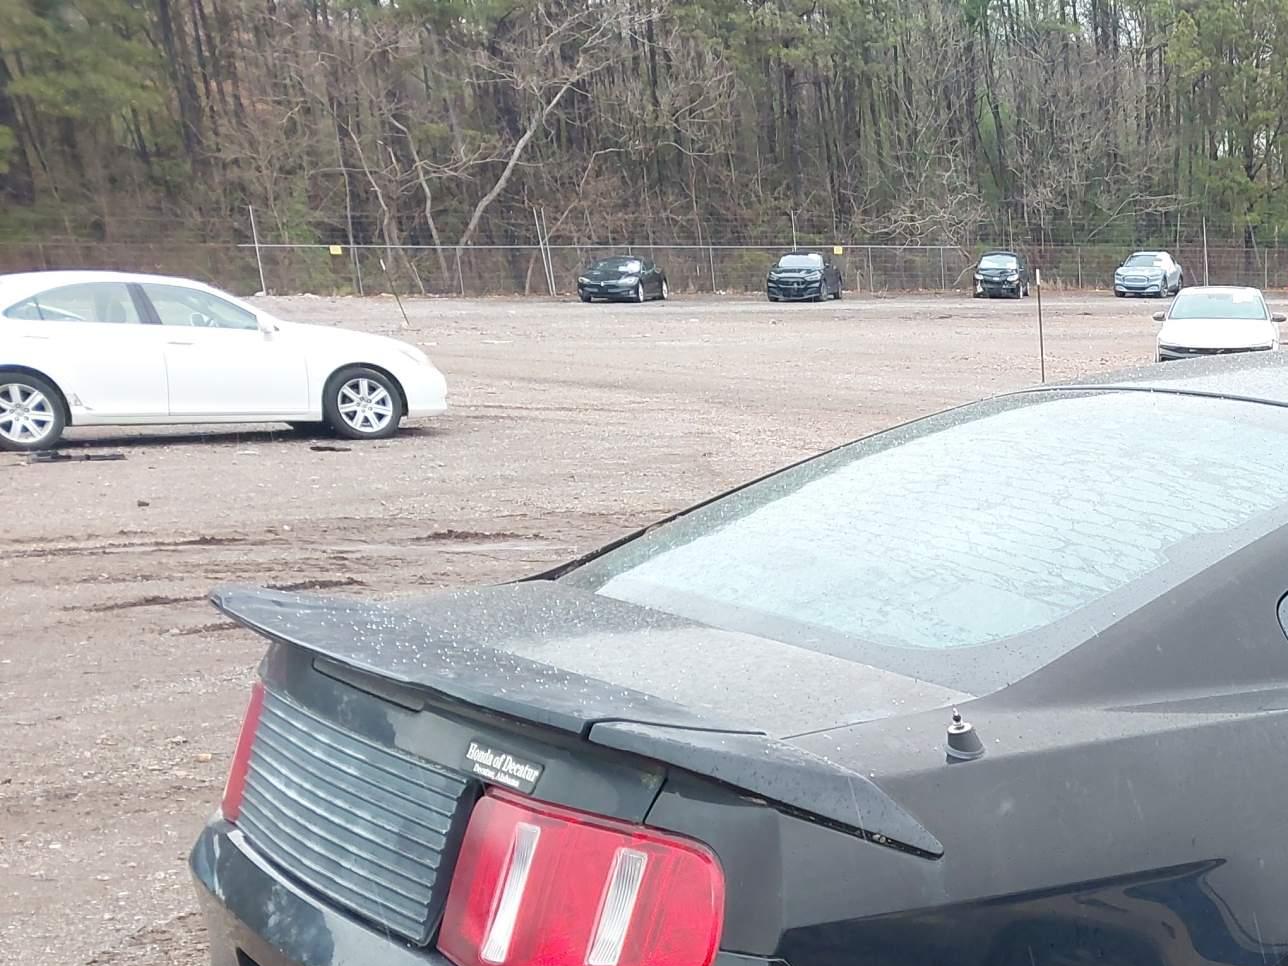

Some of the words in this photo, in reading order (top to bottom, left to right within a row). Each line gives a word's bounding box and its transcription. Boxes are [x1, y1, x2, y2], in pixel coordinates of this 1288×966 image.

[466, 742, 494, 766] Honda
[493, 754, 506, 769] of
[502, 755, 539, 782] Decatur
